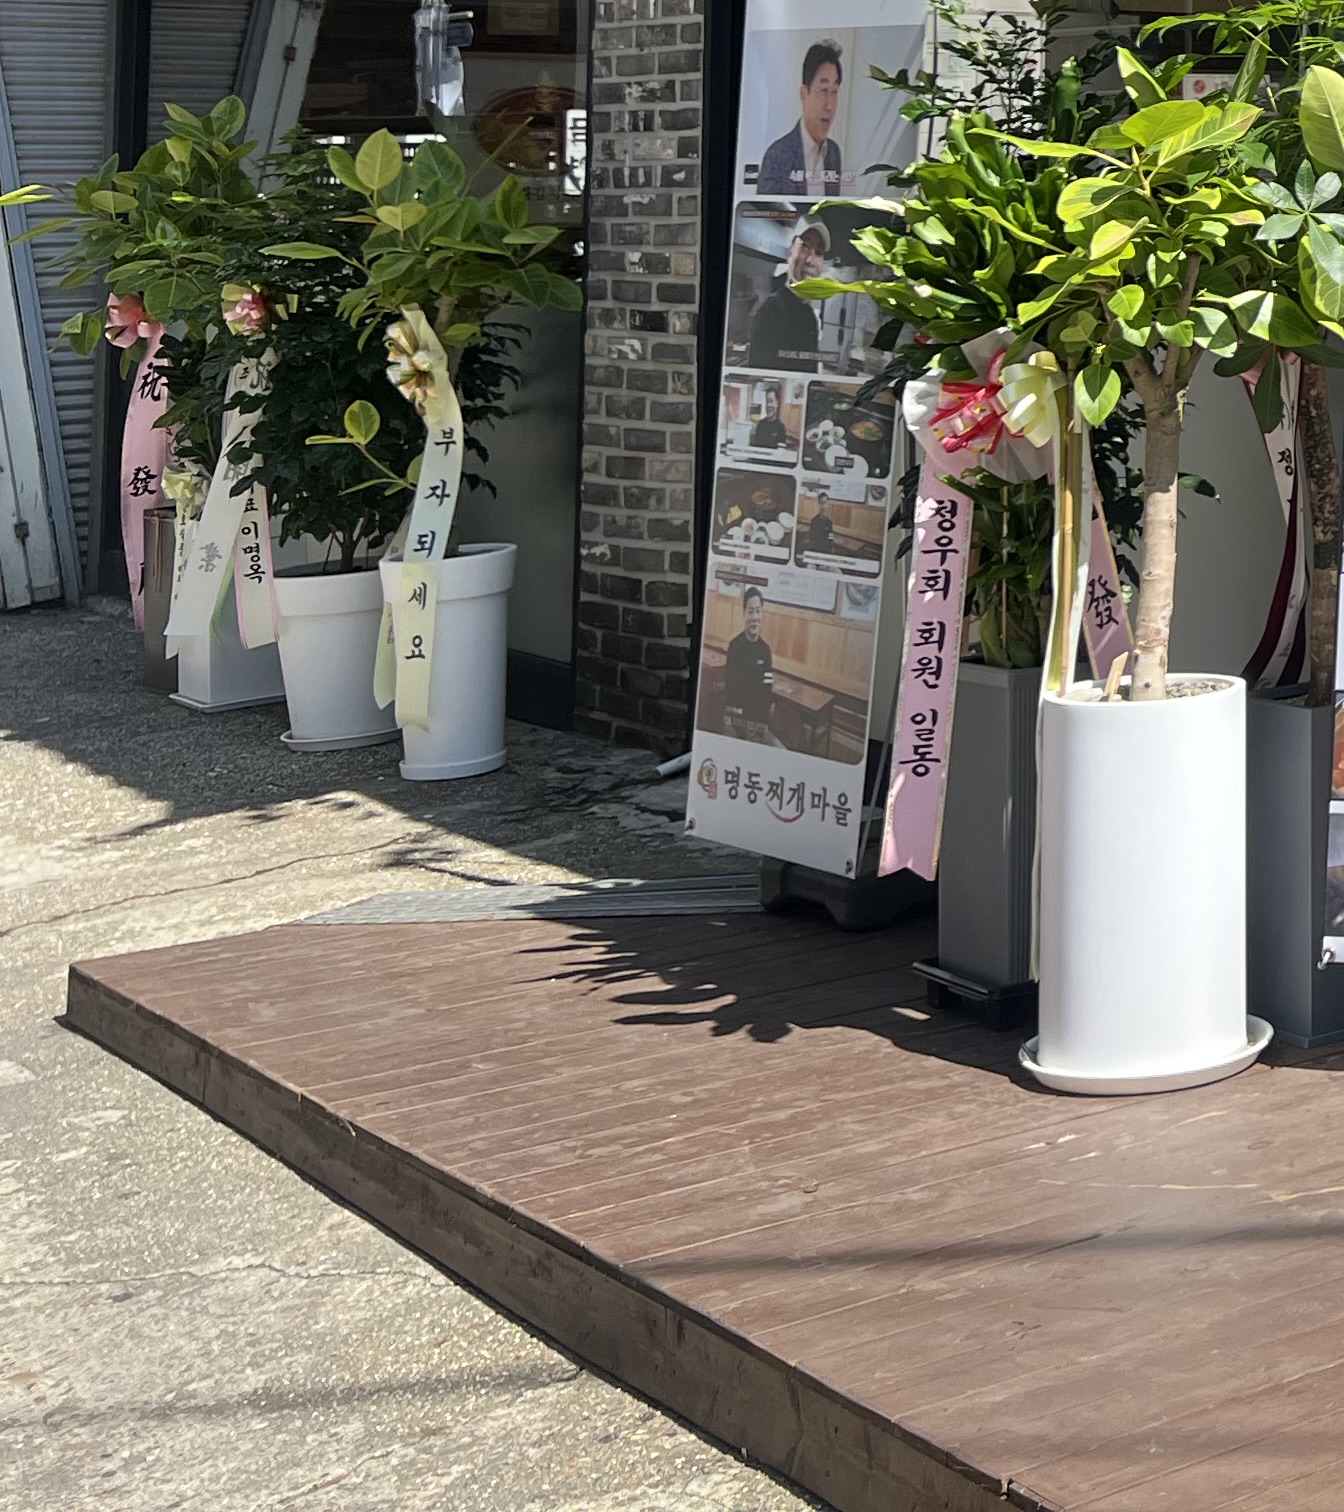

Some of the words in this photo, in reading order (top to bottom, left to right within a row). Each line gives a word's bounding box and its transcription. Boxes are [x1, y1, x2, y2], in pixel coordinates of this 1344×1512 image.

[909, 619, 947, 691] 회원
[899, 708, 942, 778] 일동
[723, 765, 853, 827] 명동찌개마을
